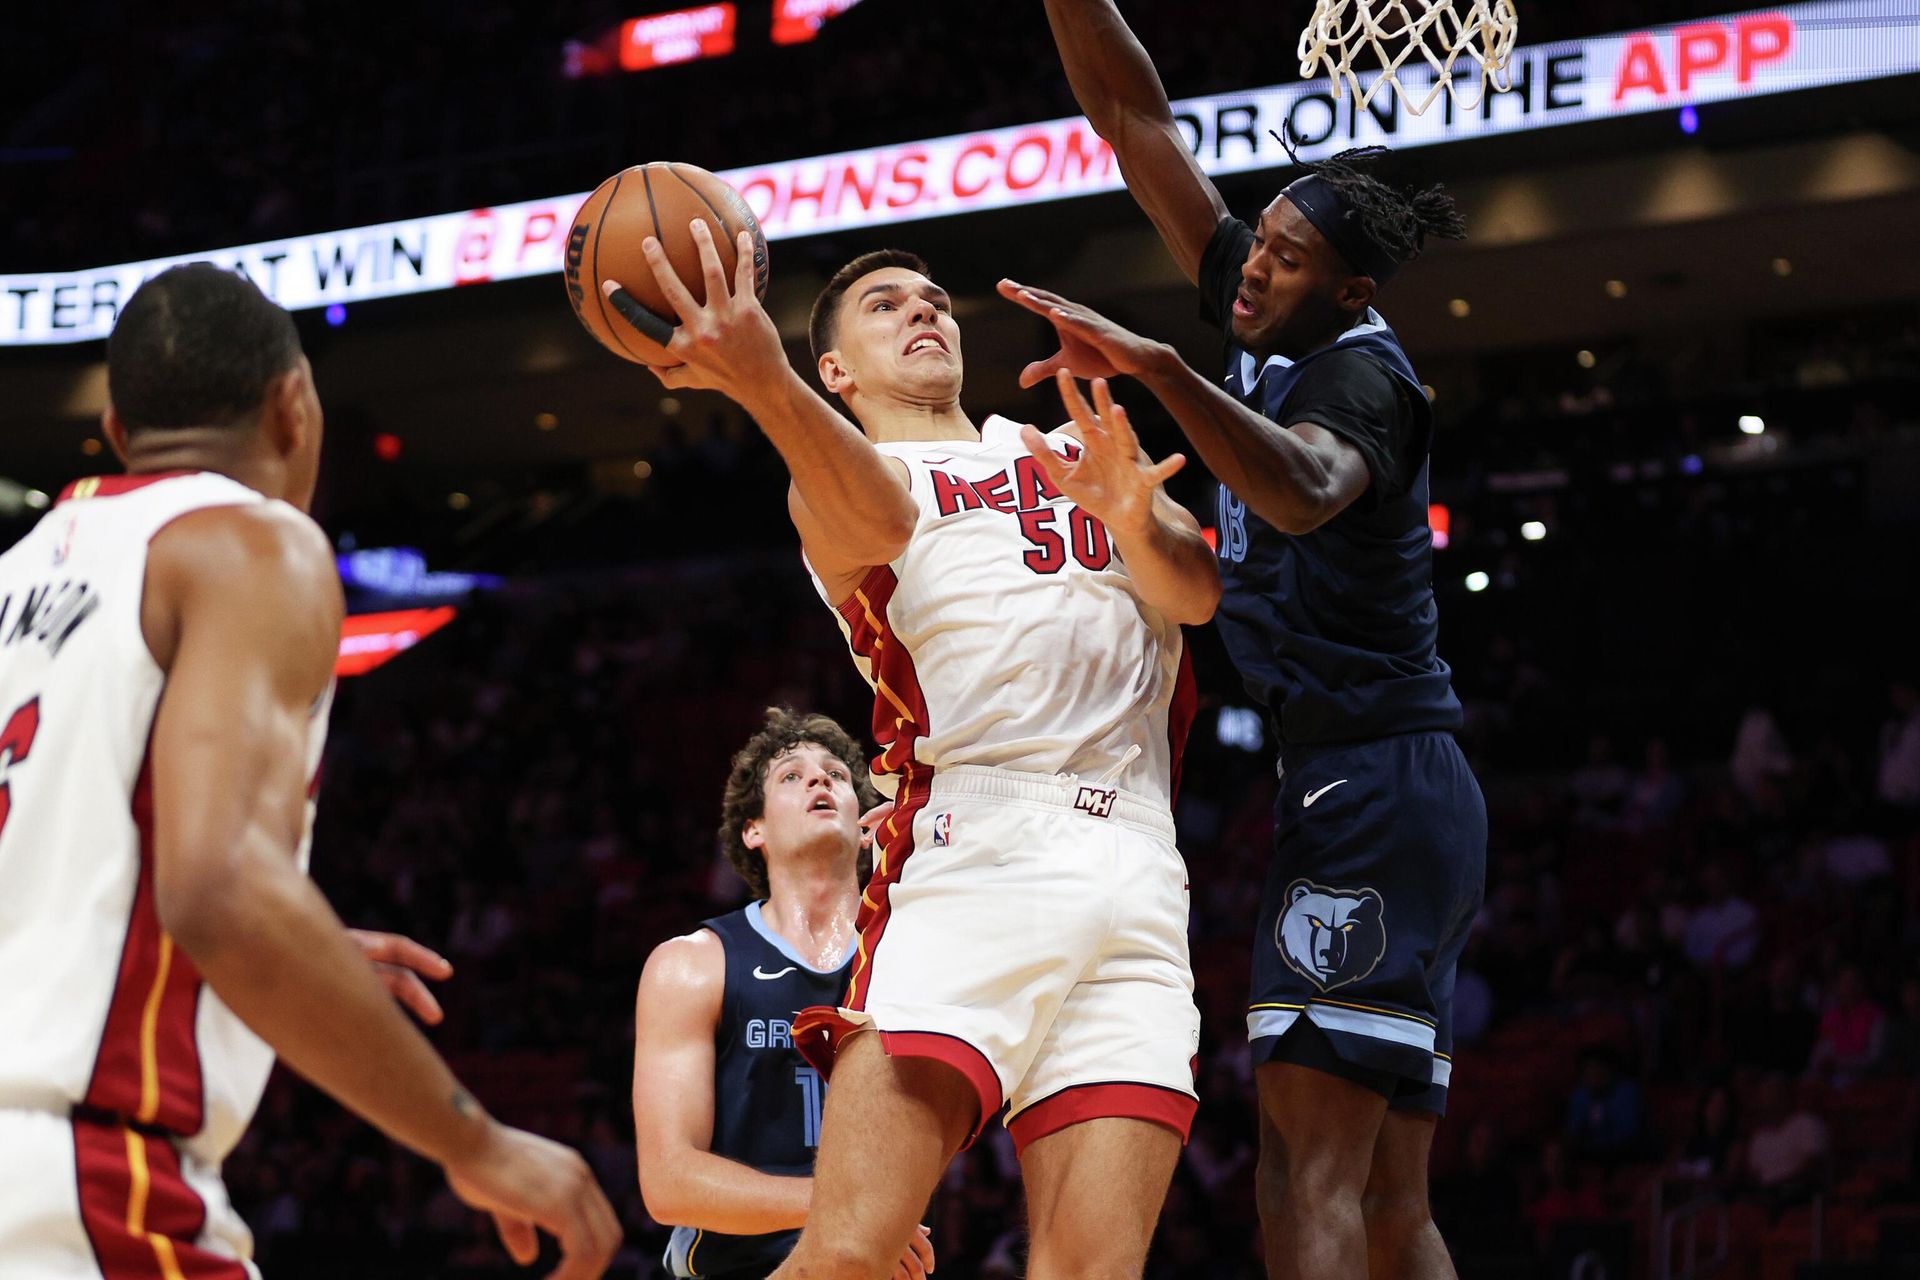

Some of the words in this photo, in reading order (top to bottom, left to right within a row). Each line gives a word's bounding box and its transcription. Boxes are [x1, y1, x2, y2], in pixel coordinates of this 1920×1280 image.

[313, 233, 428, 291] WIN
[1287, 82, 1399, 147] ON
[1429, 53, 1584, 127] THE
[1613, 14, 1794, 104] APP
[1016, 505, 1113, 575] 50
